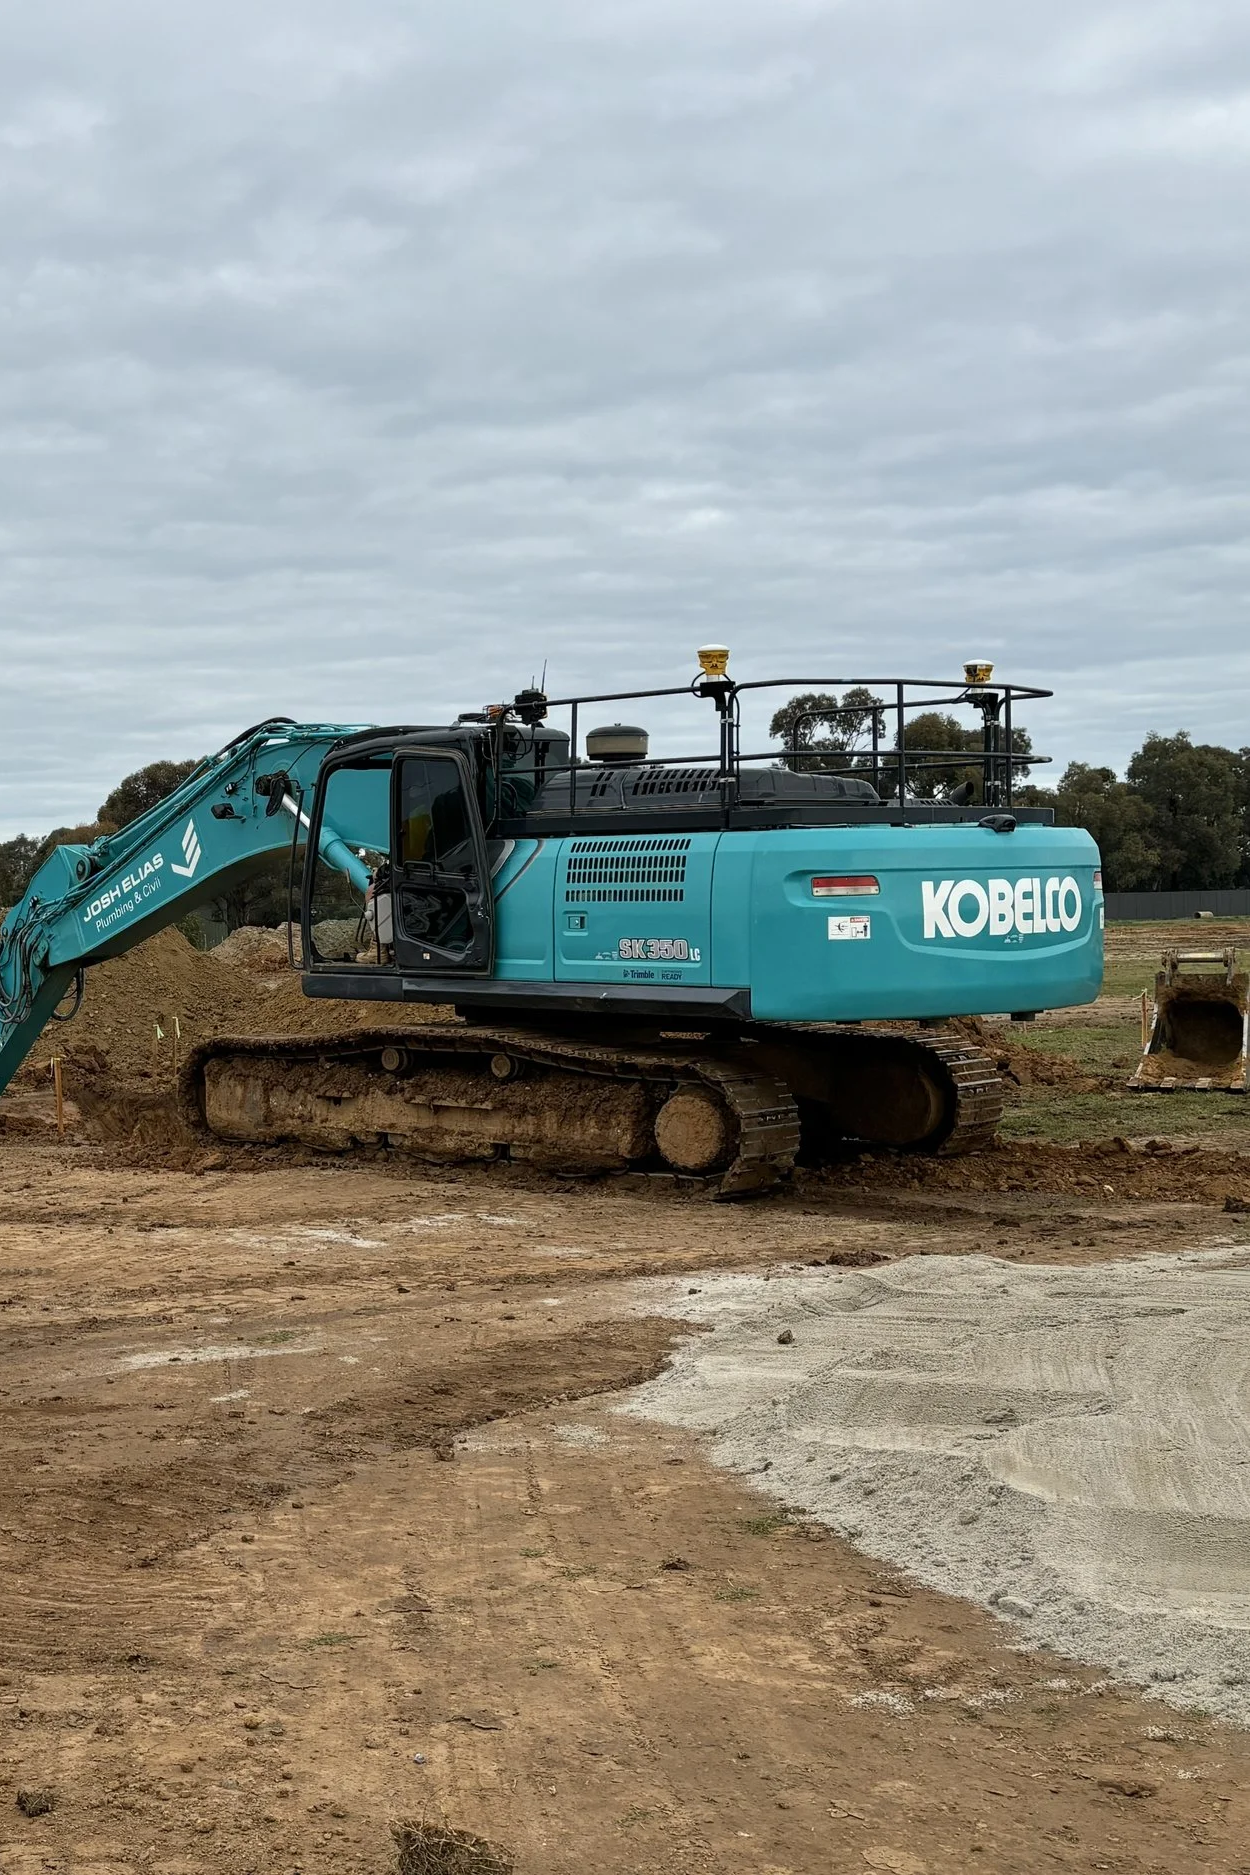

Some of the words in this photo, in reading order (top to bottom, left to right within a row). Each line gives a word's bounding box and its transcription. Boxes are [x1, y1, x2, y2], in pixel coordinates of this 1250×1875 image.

[84, 886, 122, 922] JOSH
[122, 853, 164, 893] ELIAS
[95, 899, 134, 932] Plumbing
[134, 891, 142, 904] &
[142, 876, 162, 897] Civil
[921, 876, 1082, 938] KOBELCO
[619, 938, 689, 960] SK350
[690, 948, 700, 961] LC
[630, 969, 655, 979] Trimble
